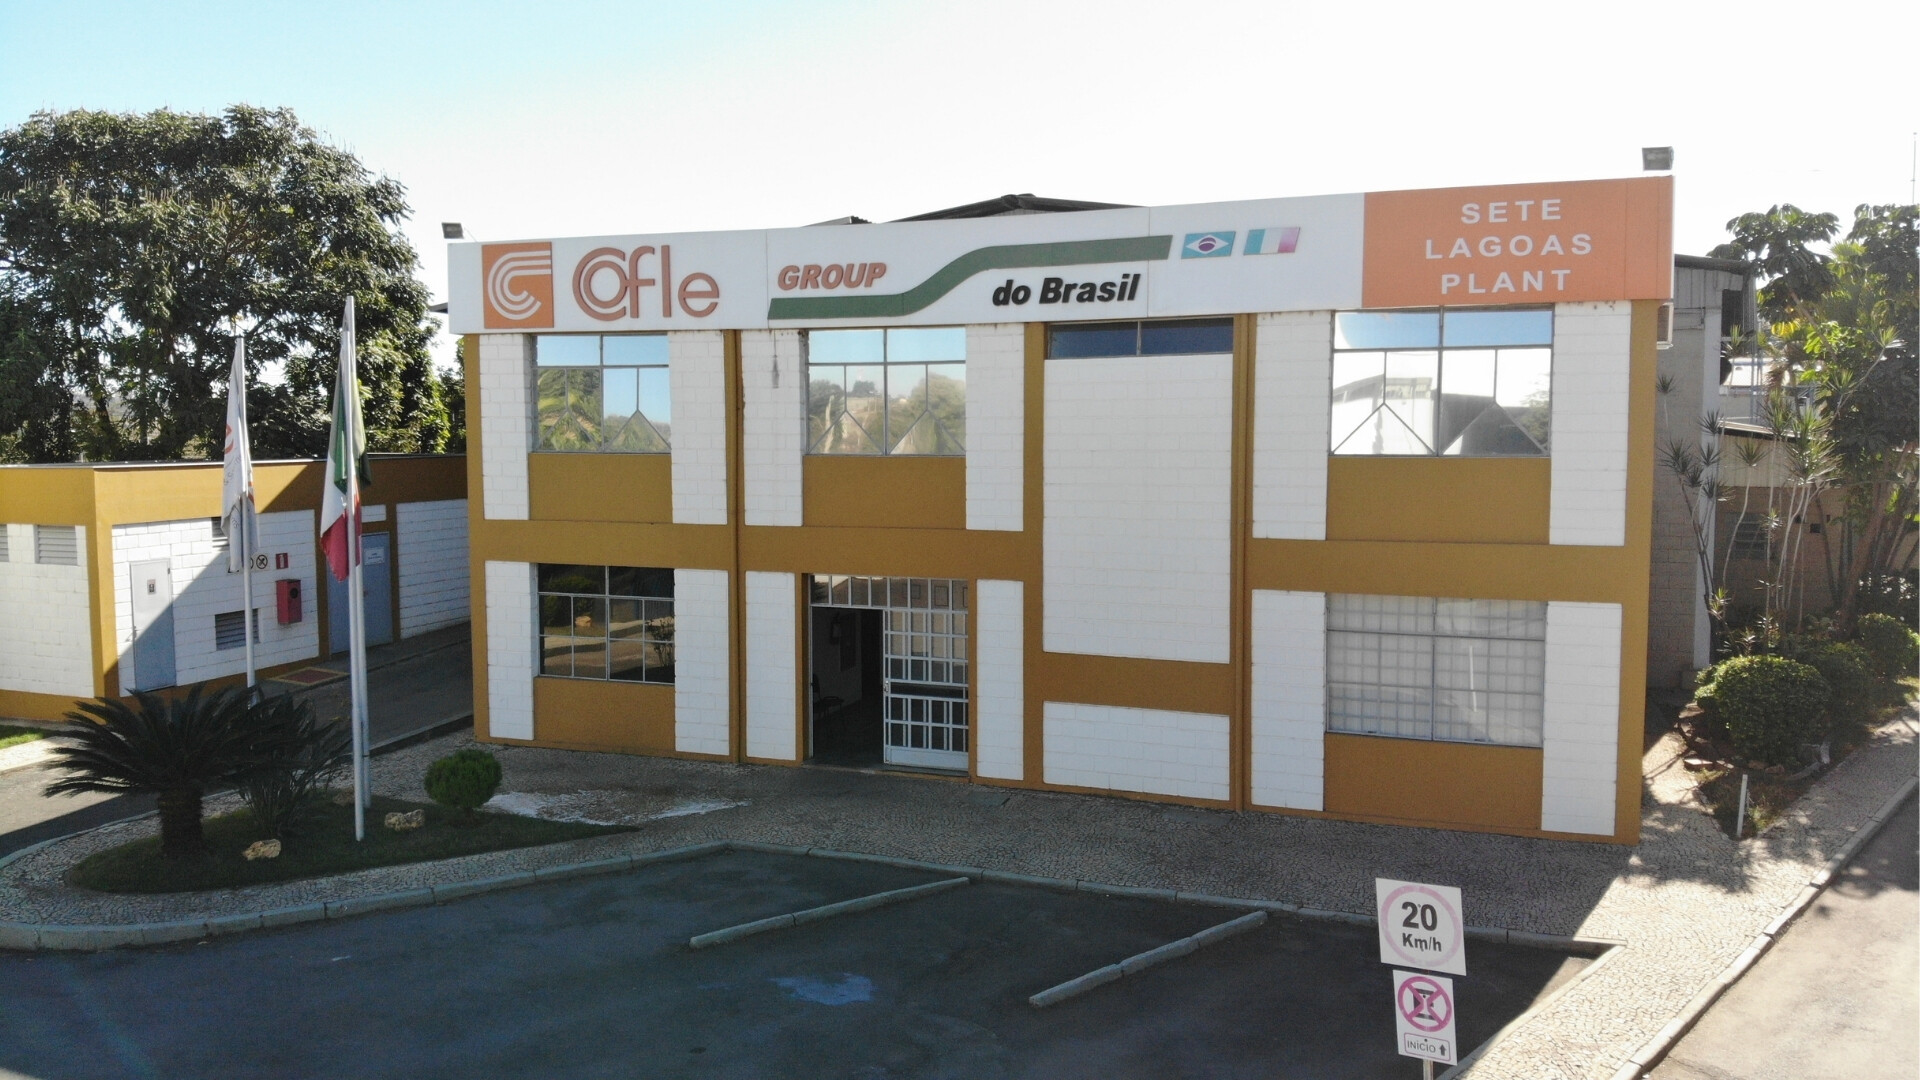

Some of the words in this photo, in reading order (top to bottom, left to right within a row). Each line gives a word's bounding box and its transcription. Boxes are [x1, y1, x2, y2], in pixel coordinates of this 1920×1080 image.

[1460, 199, 1562, 225] SETE
[1425, 233, 1593, 260] LAGOAS
[777, 261, 887, 291] GROUP
[1441, 269, 1571, 295] PLANT
[991, 279, 1031, 307] do
[1038, 273, 1141, 305] Brasil
[1401, 901, 1438, 932] 20
[1402, 933, 1442, 952] Km/h
